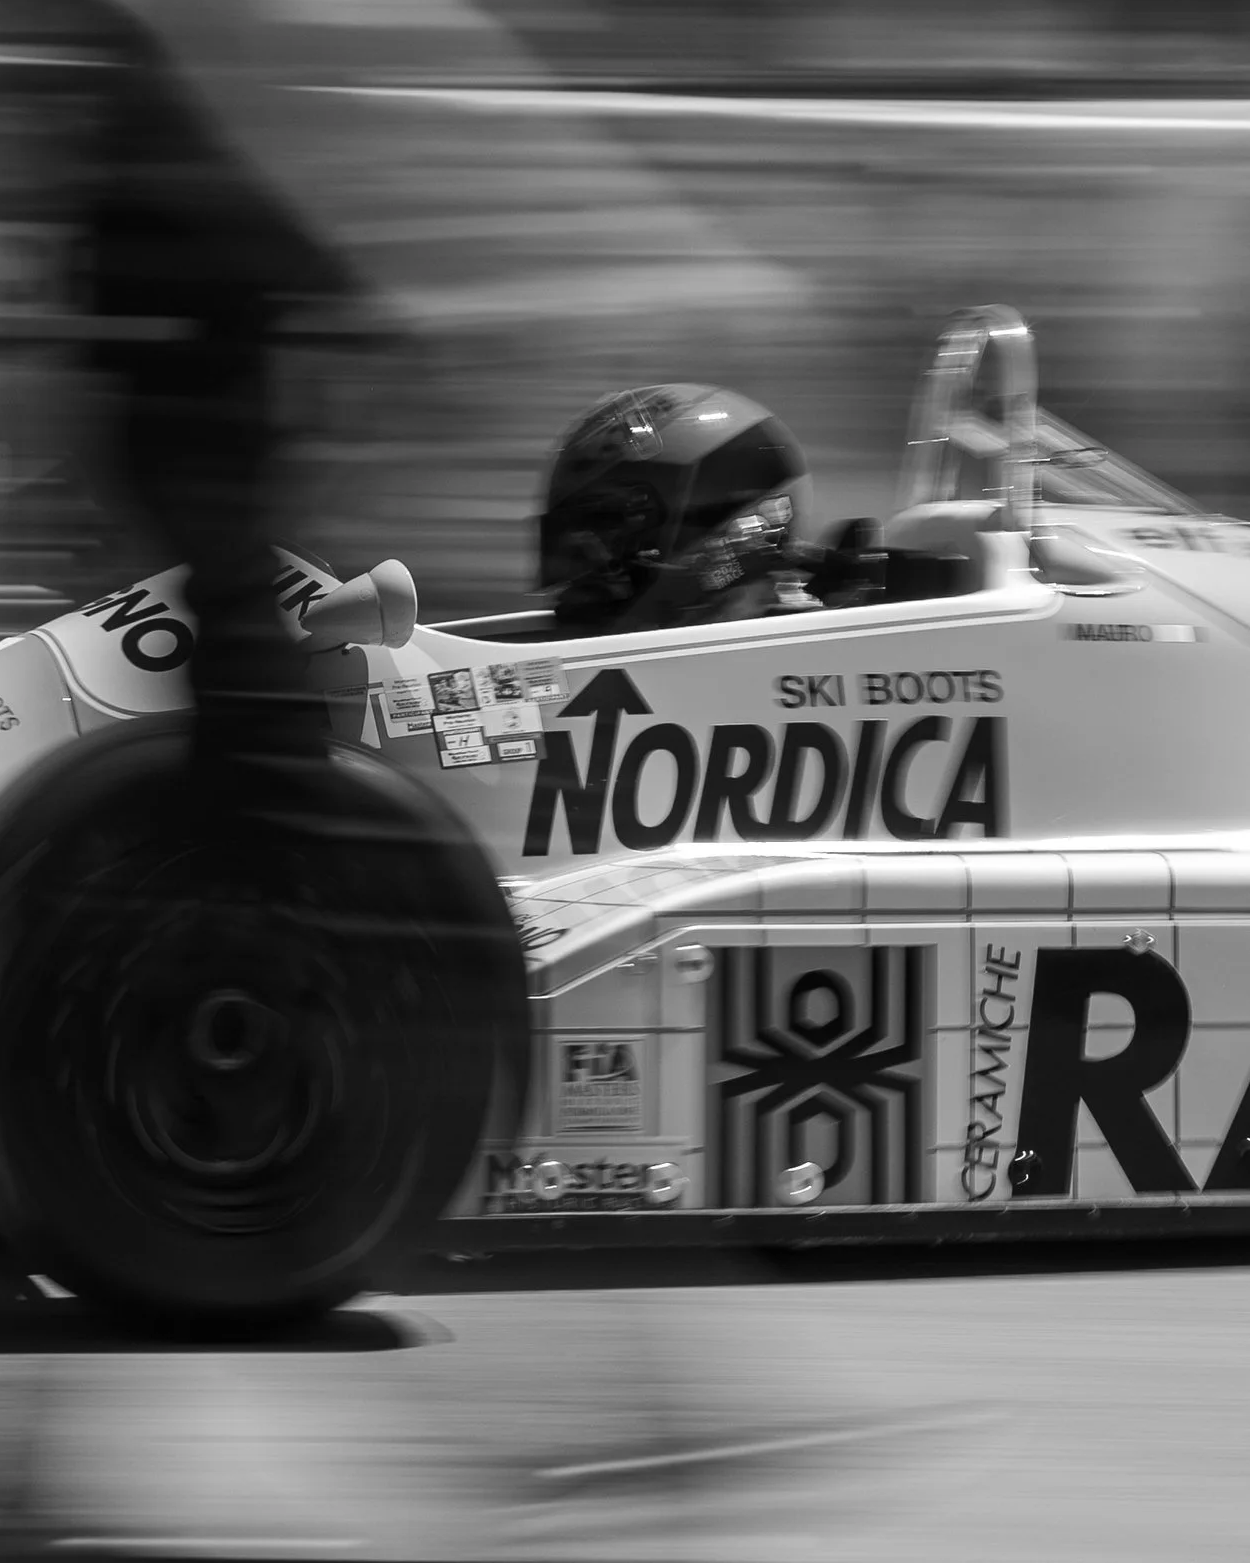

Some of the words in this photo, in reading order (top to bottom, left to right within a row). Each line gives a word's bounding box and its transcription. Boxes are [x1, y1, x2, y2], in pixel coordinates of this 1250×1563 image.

[1075, 624, 1155, 642] MAURO
[774, 674, 847, 708] SKI
[858, 670, 1004, 705] BOOTS
[522, 704, 1010, 857] NORDICA
[961, 943, 1021, 1202] CERAMICHE
